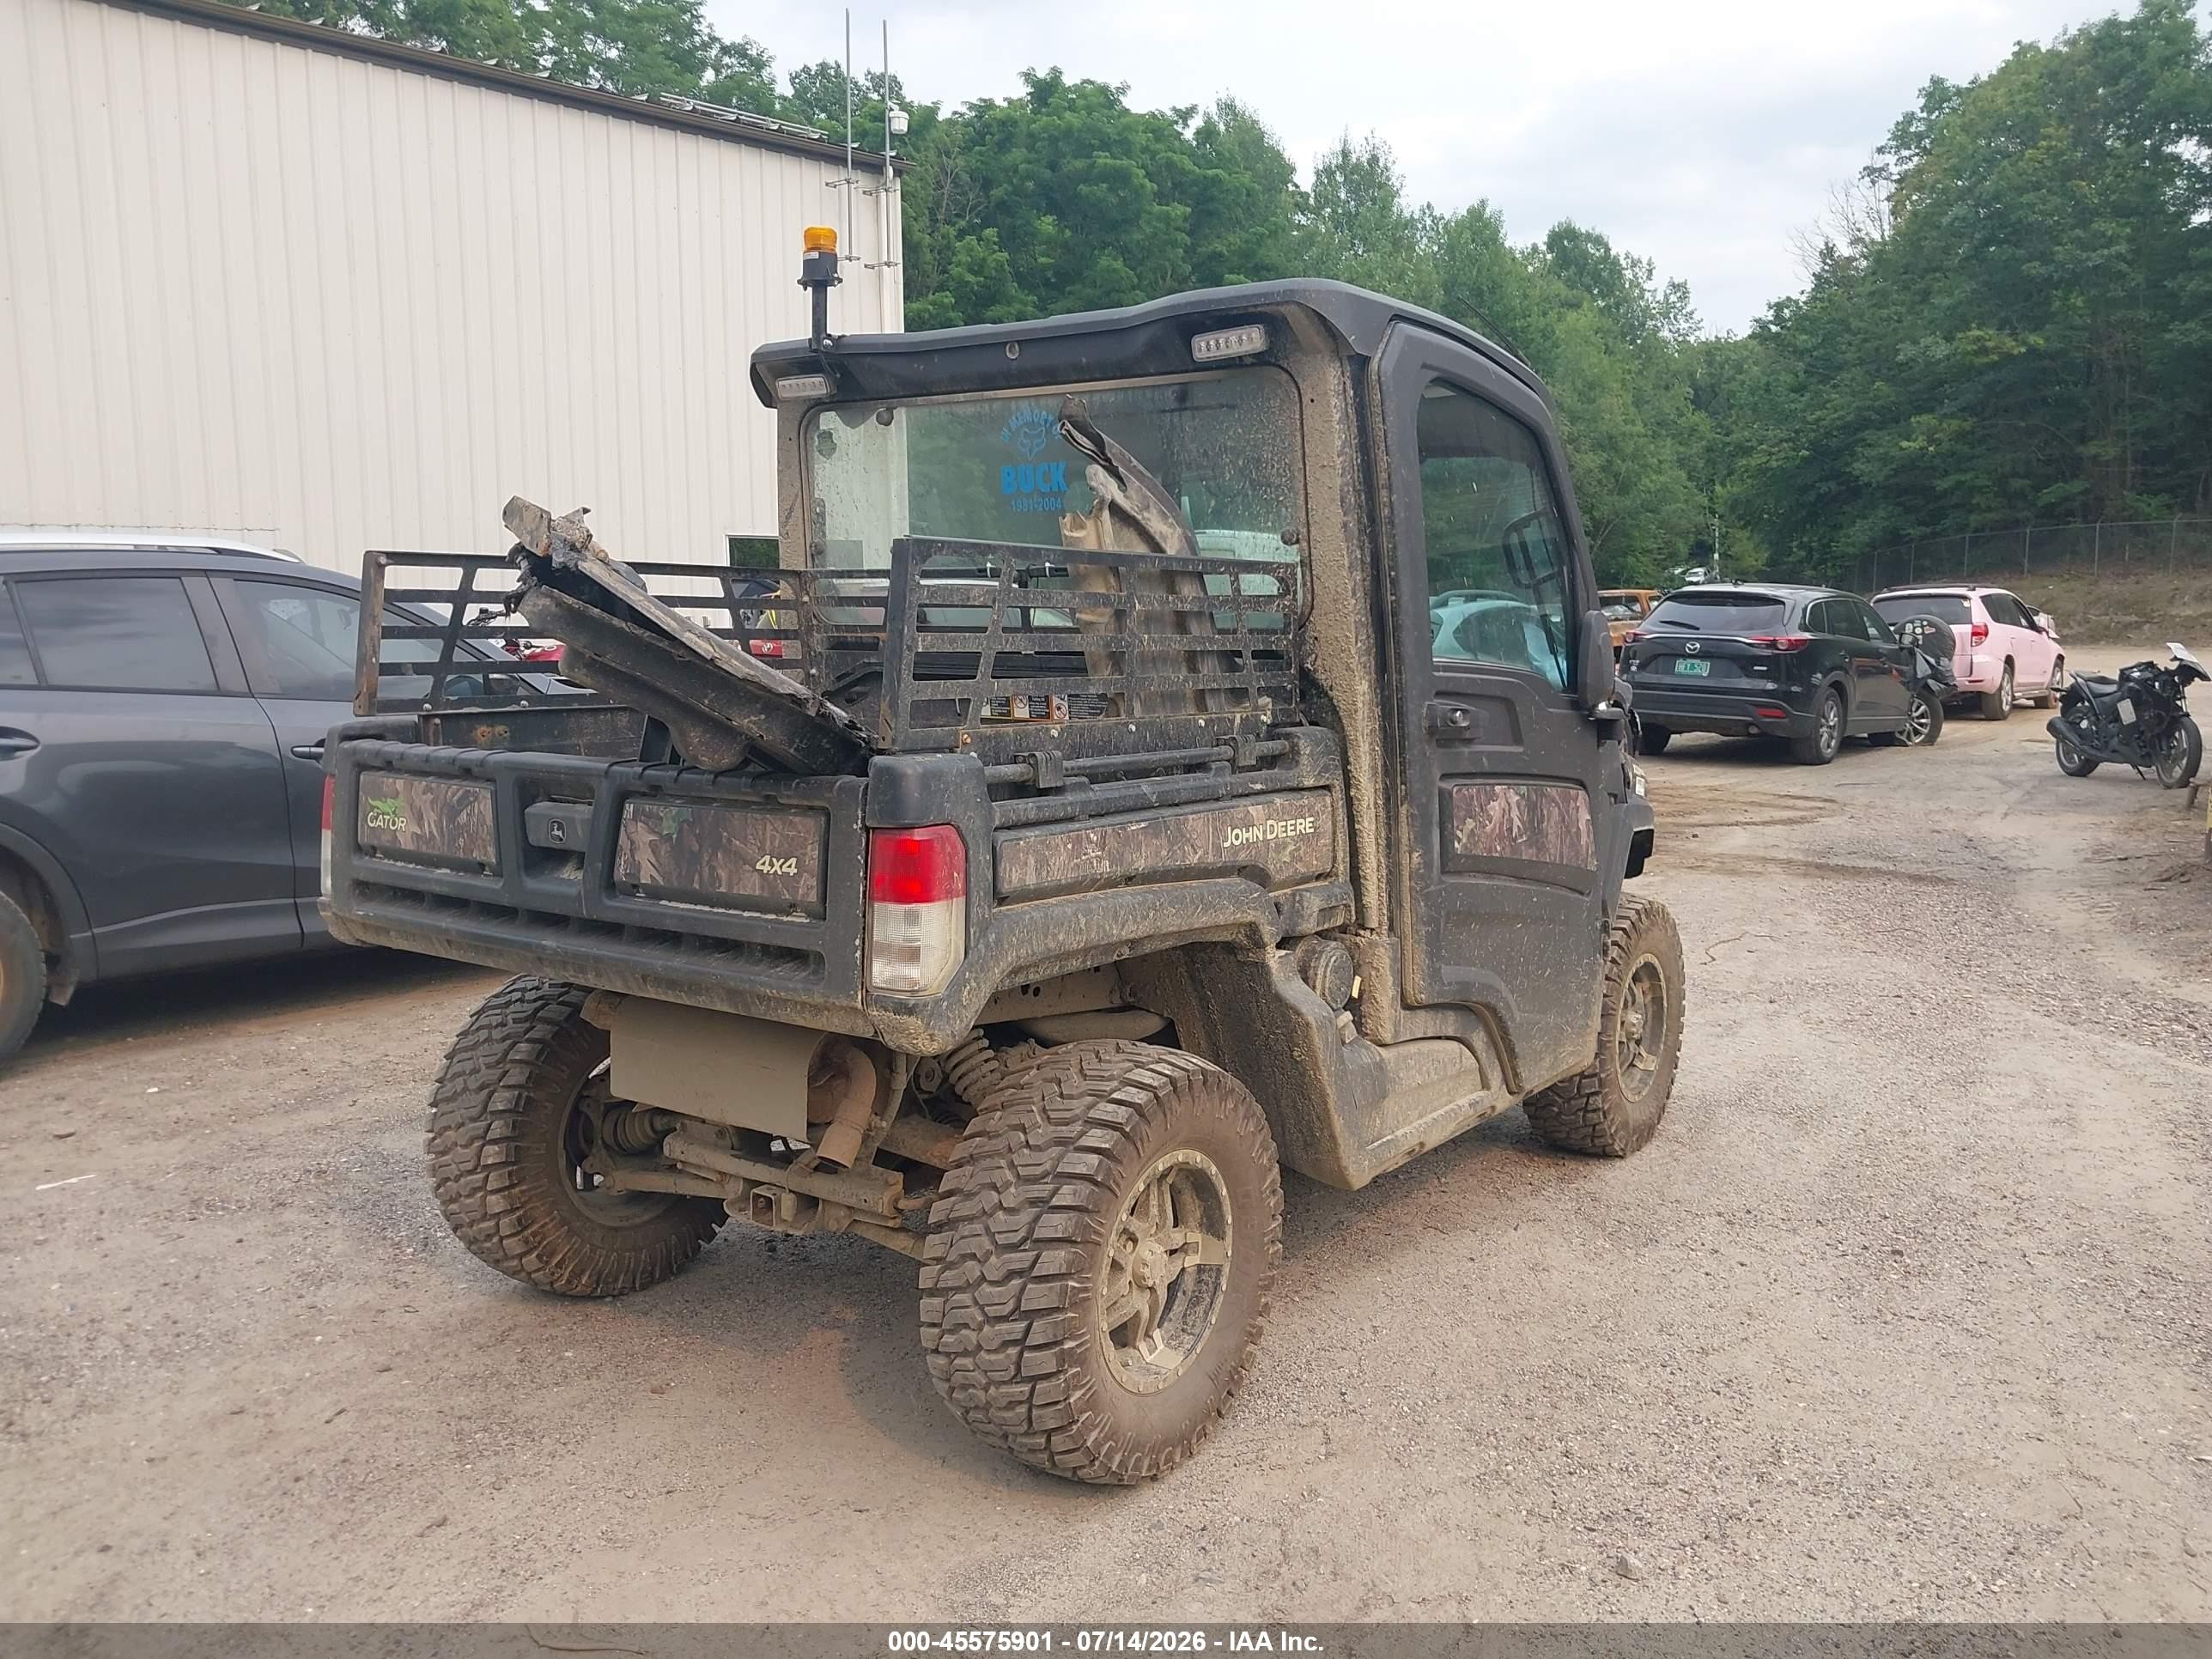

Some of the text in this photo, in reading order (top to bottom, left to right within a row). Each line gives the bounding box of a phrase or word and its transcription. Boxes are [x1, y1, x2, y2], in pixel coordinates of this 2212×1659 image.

[1001, 461, 1068, 495] BUCK
[368, 811, 407, 832] GATOR
[1224, 817, 1315, 848] JOHN DEERE
